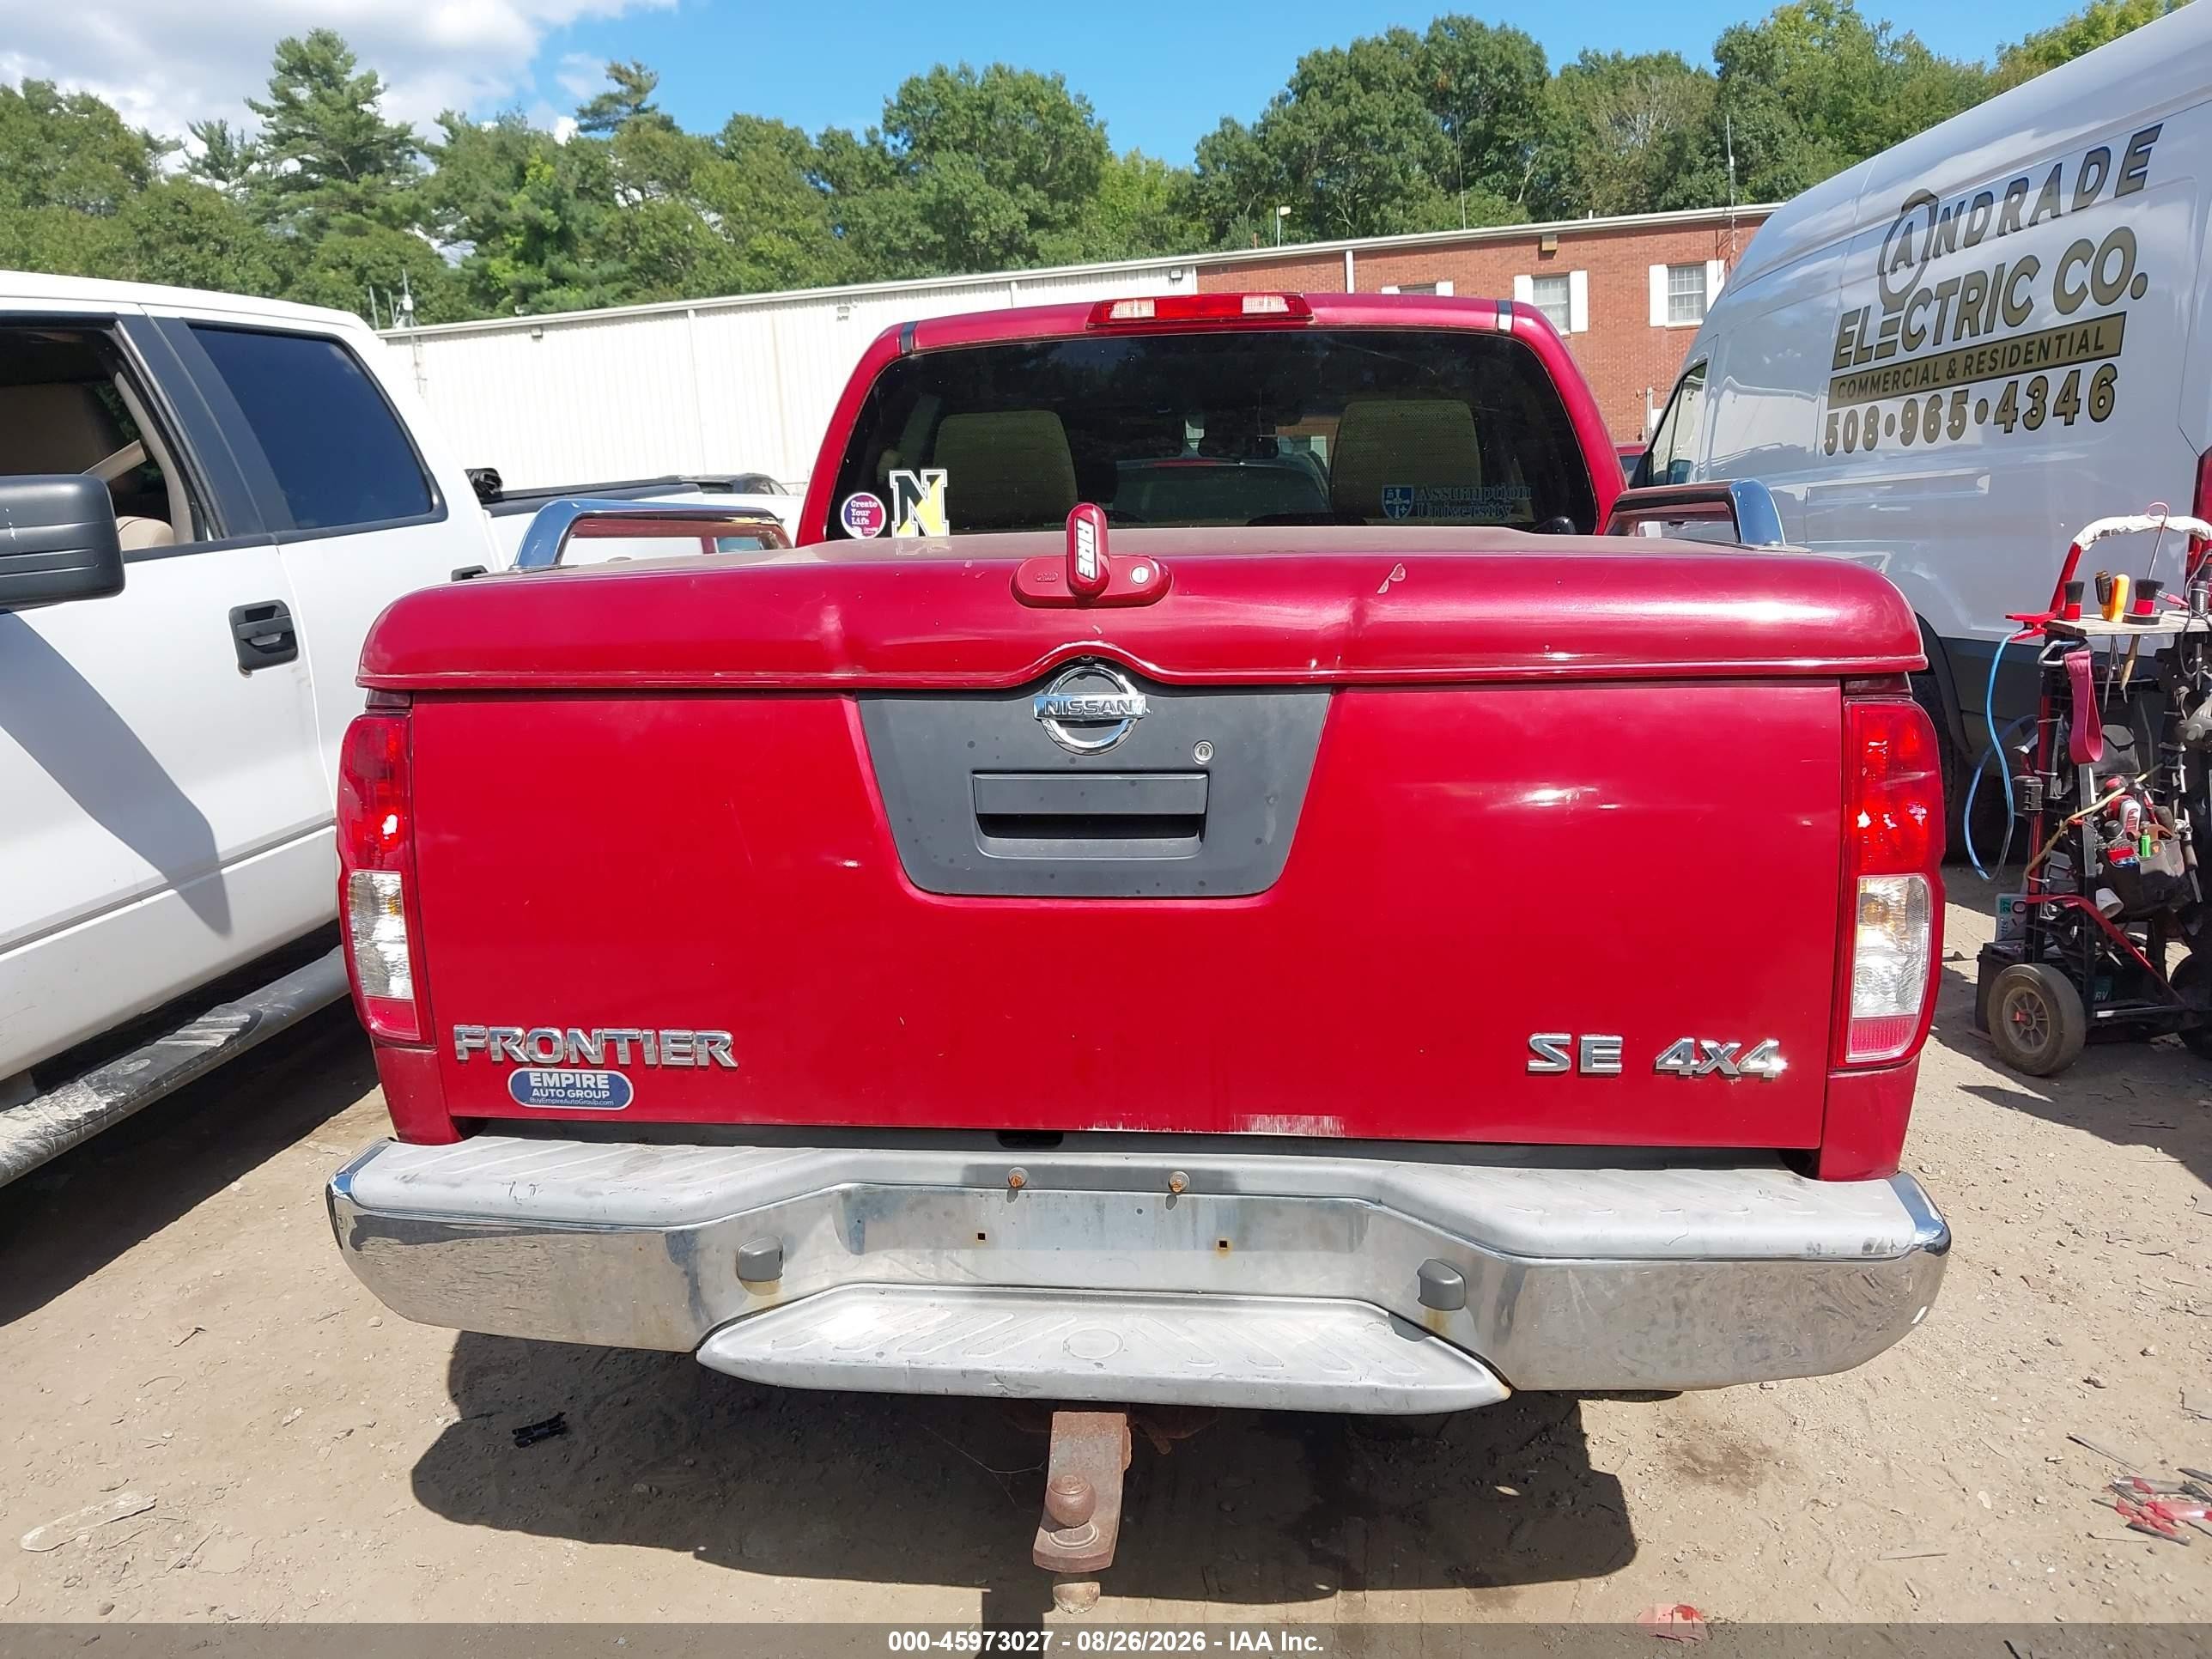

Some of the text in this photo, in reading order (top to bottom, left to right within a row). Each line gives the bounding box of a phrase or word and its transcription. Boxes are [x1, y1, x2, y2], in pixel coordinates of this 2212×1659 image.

[1882, 123, 2164, 276] ANDRADE
[1832, 226, 2148, 371] ELECTRIC CO.
[1837, 326, 2106, 398] COMMERCIAL & RESIDENTIAL
[1417, 483, 1532, 503] Assumption
[850, 500, 878, 508] Create
[851, 508, 872, 517] Your
[890, 469, 950, 537] N
[1418, 502, 1513, 521] University
[851, 517, 870, 526] Life
[1044, 699, 1133, 716] NISSAN
[453, 1024, 738, 1067] FRONTIER
[1528, 1032, 1624, 1073] SE
[529, 1072, 610, 1089] EMPIRE
[529, 1097, 614, 1106] BuyEmpireAutoGroup.com
[532, 1088, 610, 1099] AUTO GROUP
